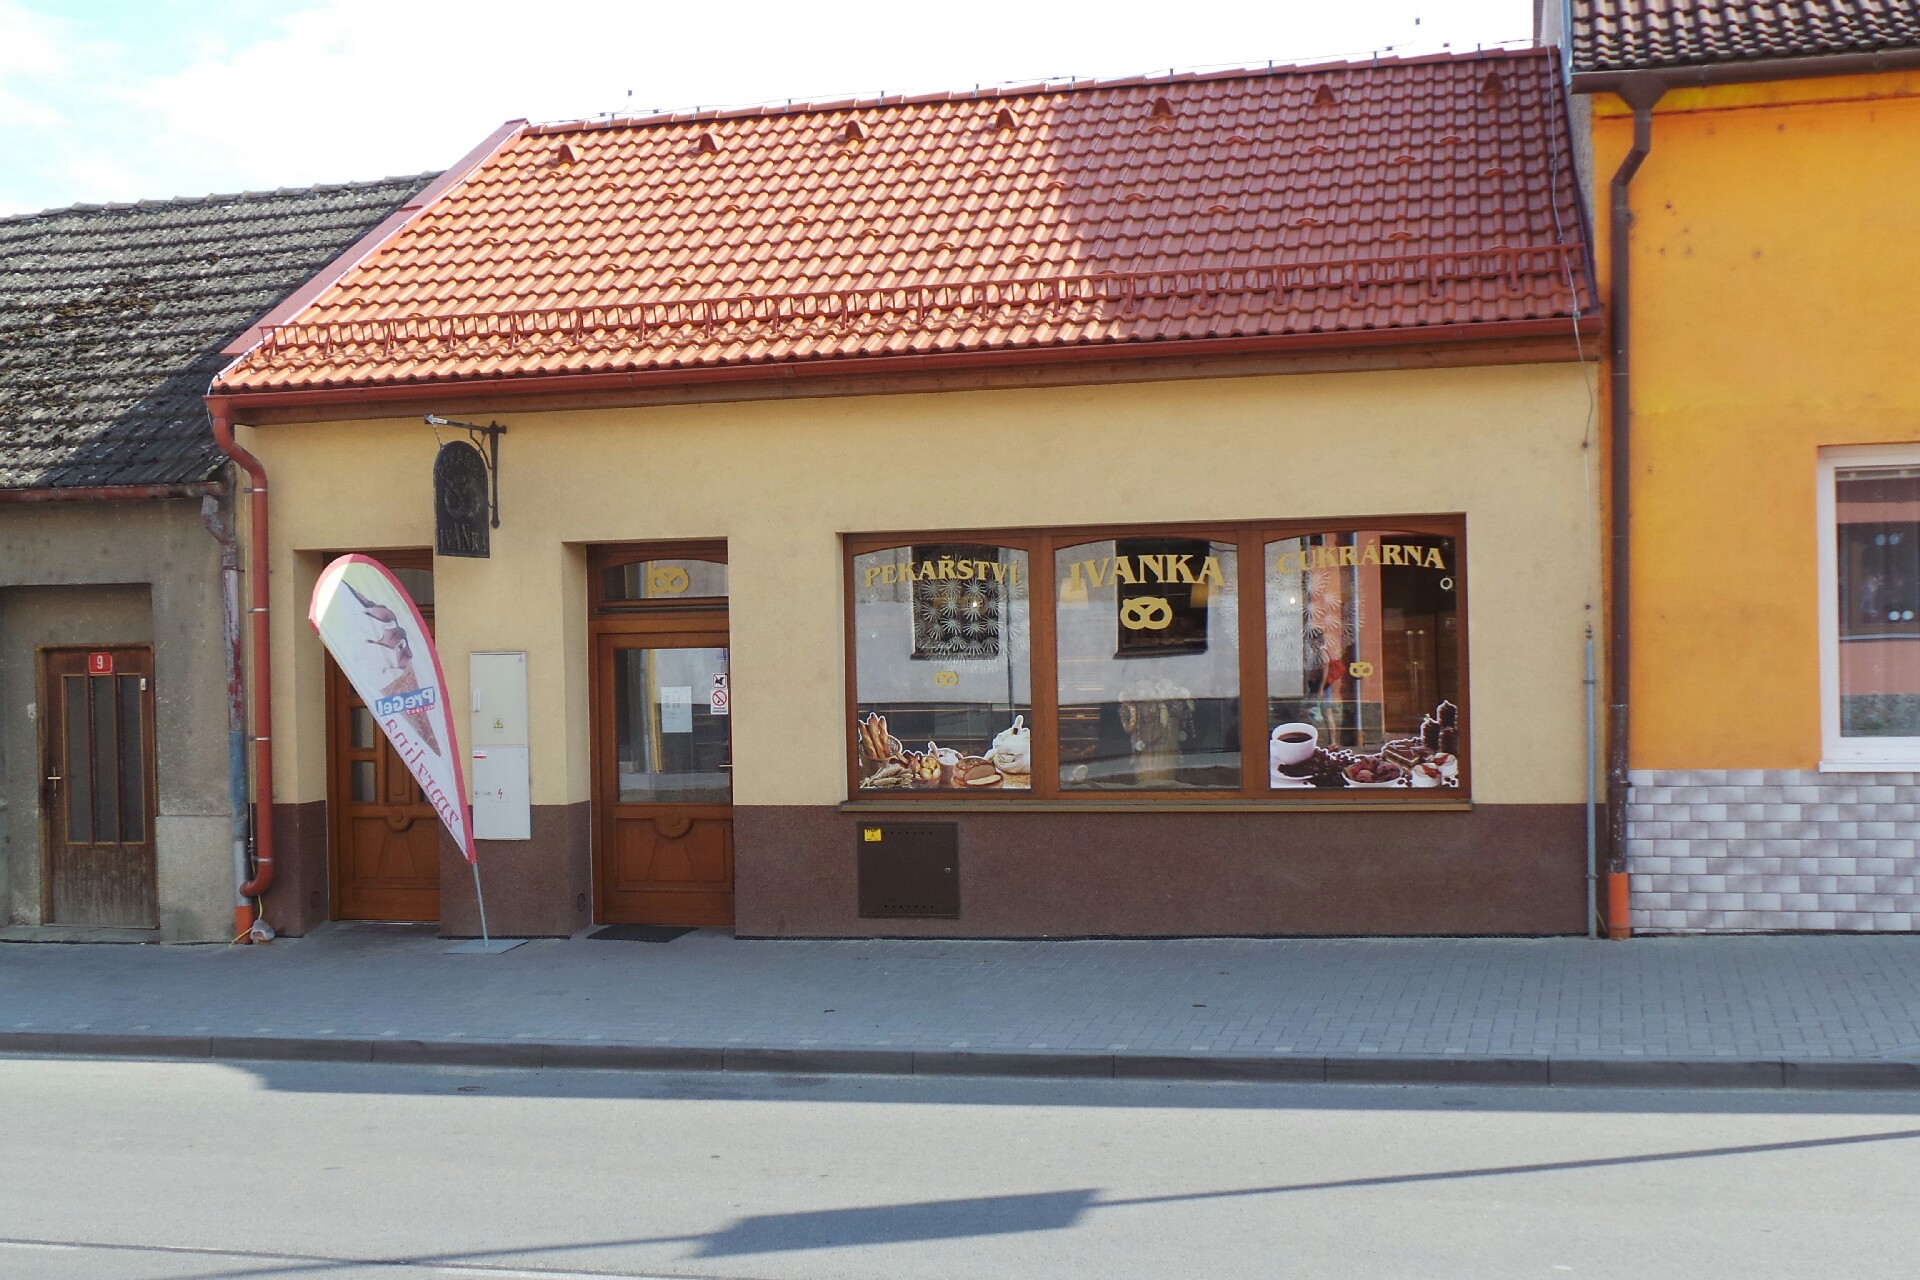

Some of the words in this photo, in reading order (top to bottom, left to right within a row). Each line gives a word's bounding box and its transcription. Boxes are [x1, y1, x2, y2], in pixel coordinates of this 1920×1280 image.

[864, 554, 1019, 589] PEKAŘSTVÍ
[1069, 554, 1226, 592] IVANKA
[1276, 538, 1446, 575] CUKRÁRNA
[96, 655, 104, 670] 9
